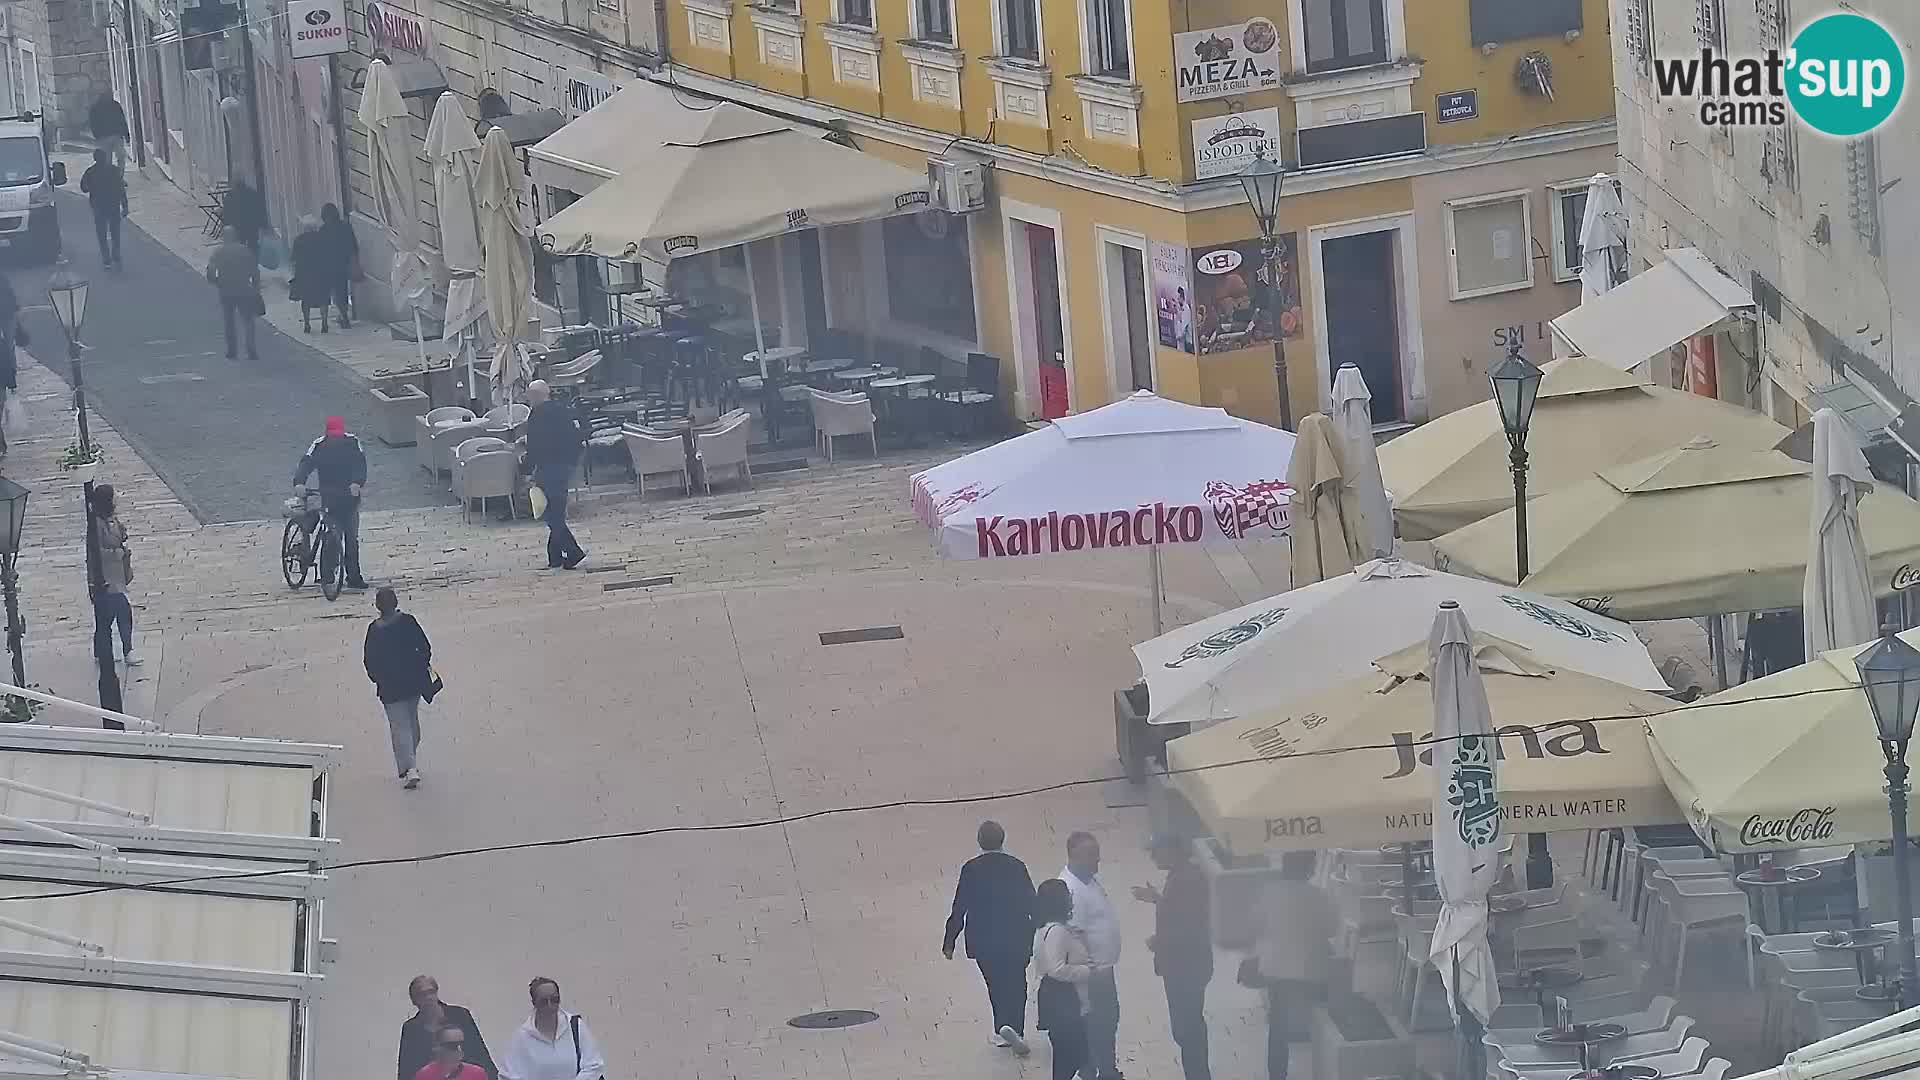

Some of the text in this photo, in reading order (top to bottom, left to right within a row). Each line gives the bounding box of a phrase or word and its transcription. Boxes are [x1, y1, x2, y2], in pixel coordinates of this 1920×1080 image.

[297, 27, 342, 41] SUKNO
[384, 11, 423, 50] SUKNO
[1180, 57, 1259, 88] MEZA
[1189, 79, 1250, 96] PIZZERIA & GRILL
[1451, 96, 1463, 105] PUT
[1442, 105, 1473, 117] PETROVCA
[1199, 143, 1245, 161] ISPOD
[1249, 137, 1277, 153] URE
[976, 502, 1202, 558] Karlovačko
[1385, 798, 1627, 829] NATU NERAL WATER
[1740, 807, 1837, 846] Coca-Cola
[1264, 816, 1325, 842] jana
